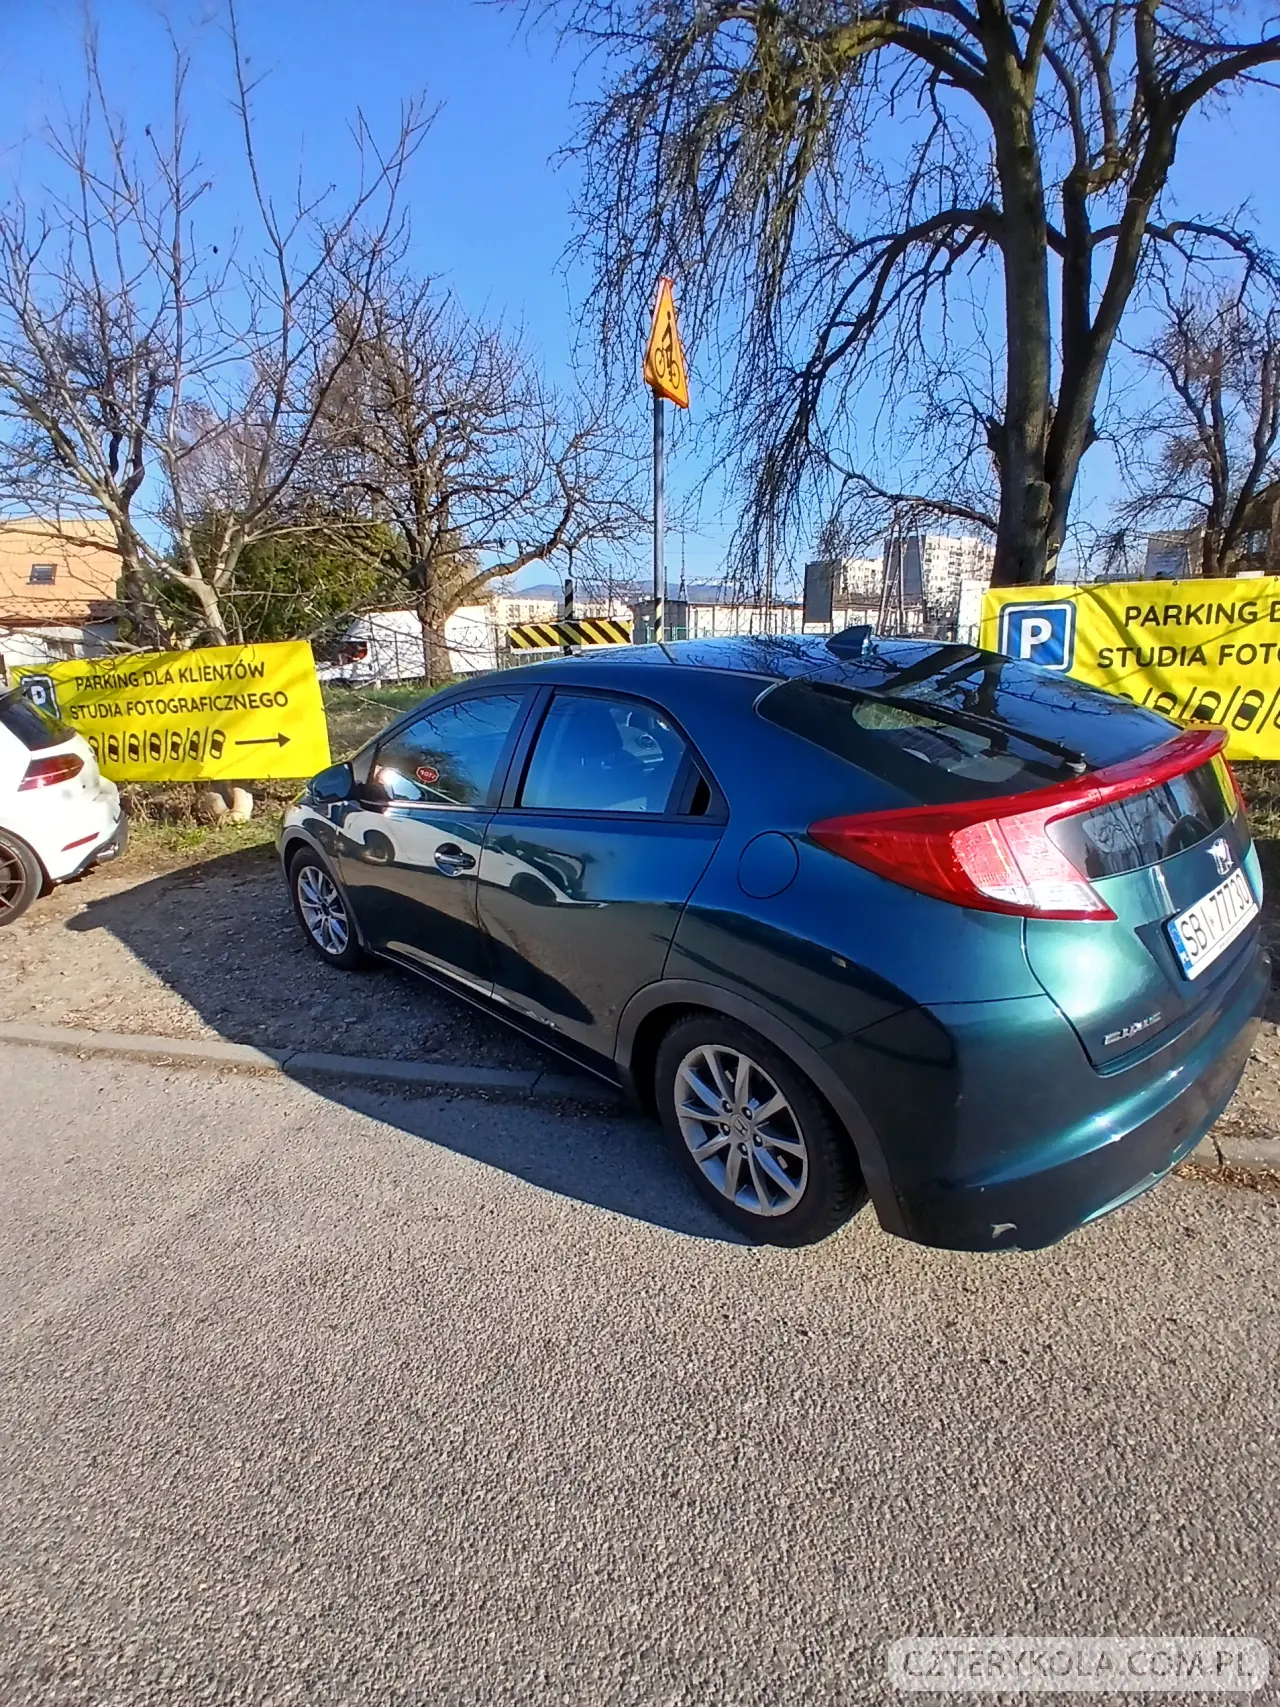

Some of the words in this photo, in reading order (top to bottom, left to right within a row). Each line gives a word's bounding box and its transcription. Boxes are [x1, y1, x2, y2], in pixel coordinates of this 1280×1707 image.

[1124, 602, 1258, 627] PARKING
[1019, 617, 1053, 659] P
[1097, 644, 1207, 668] STUDIA
[1218, 643, 1280, 666] FOT
[75, 672, 138, 692] PARKING
[143, 669, 175, 687] DLA
[178, 659, 266, 682] KLIENTÓW
[69, 702, 124, 720] STUDIA
[126, 690, 289, 717] FOTOGRAFICZNEGO
[1208, 873, 1250, 932] 77730
